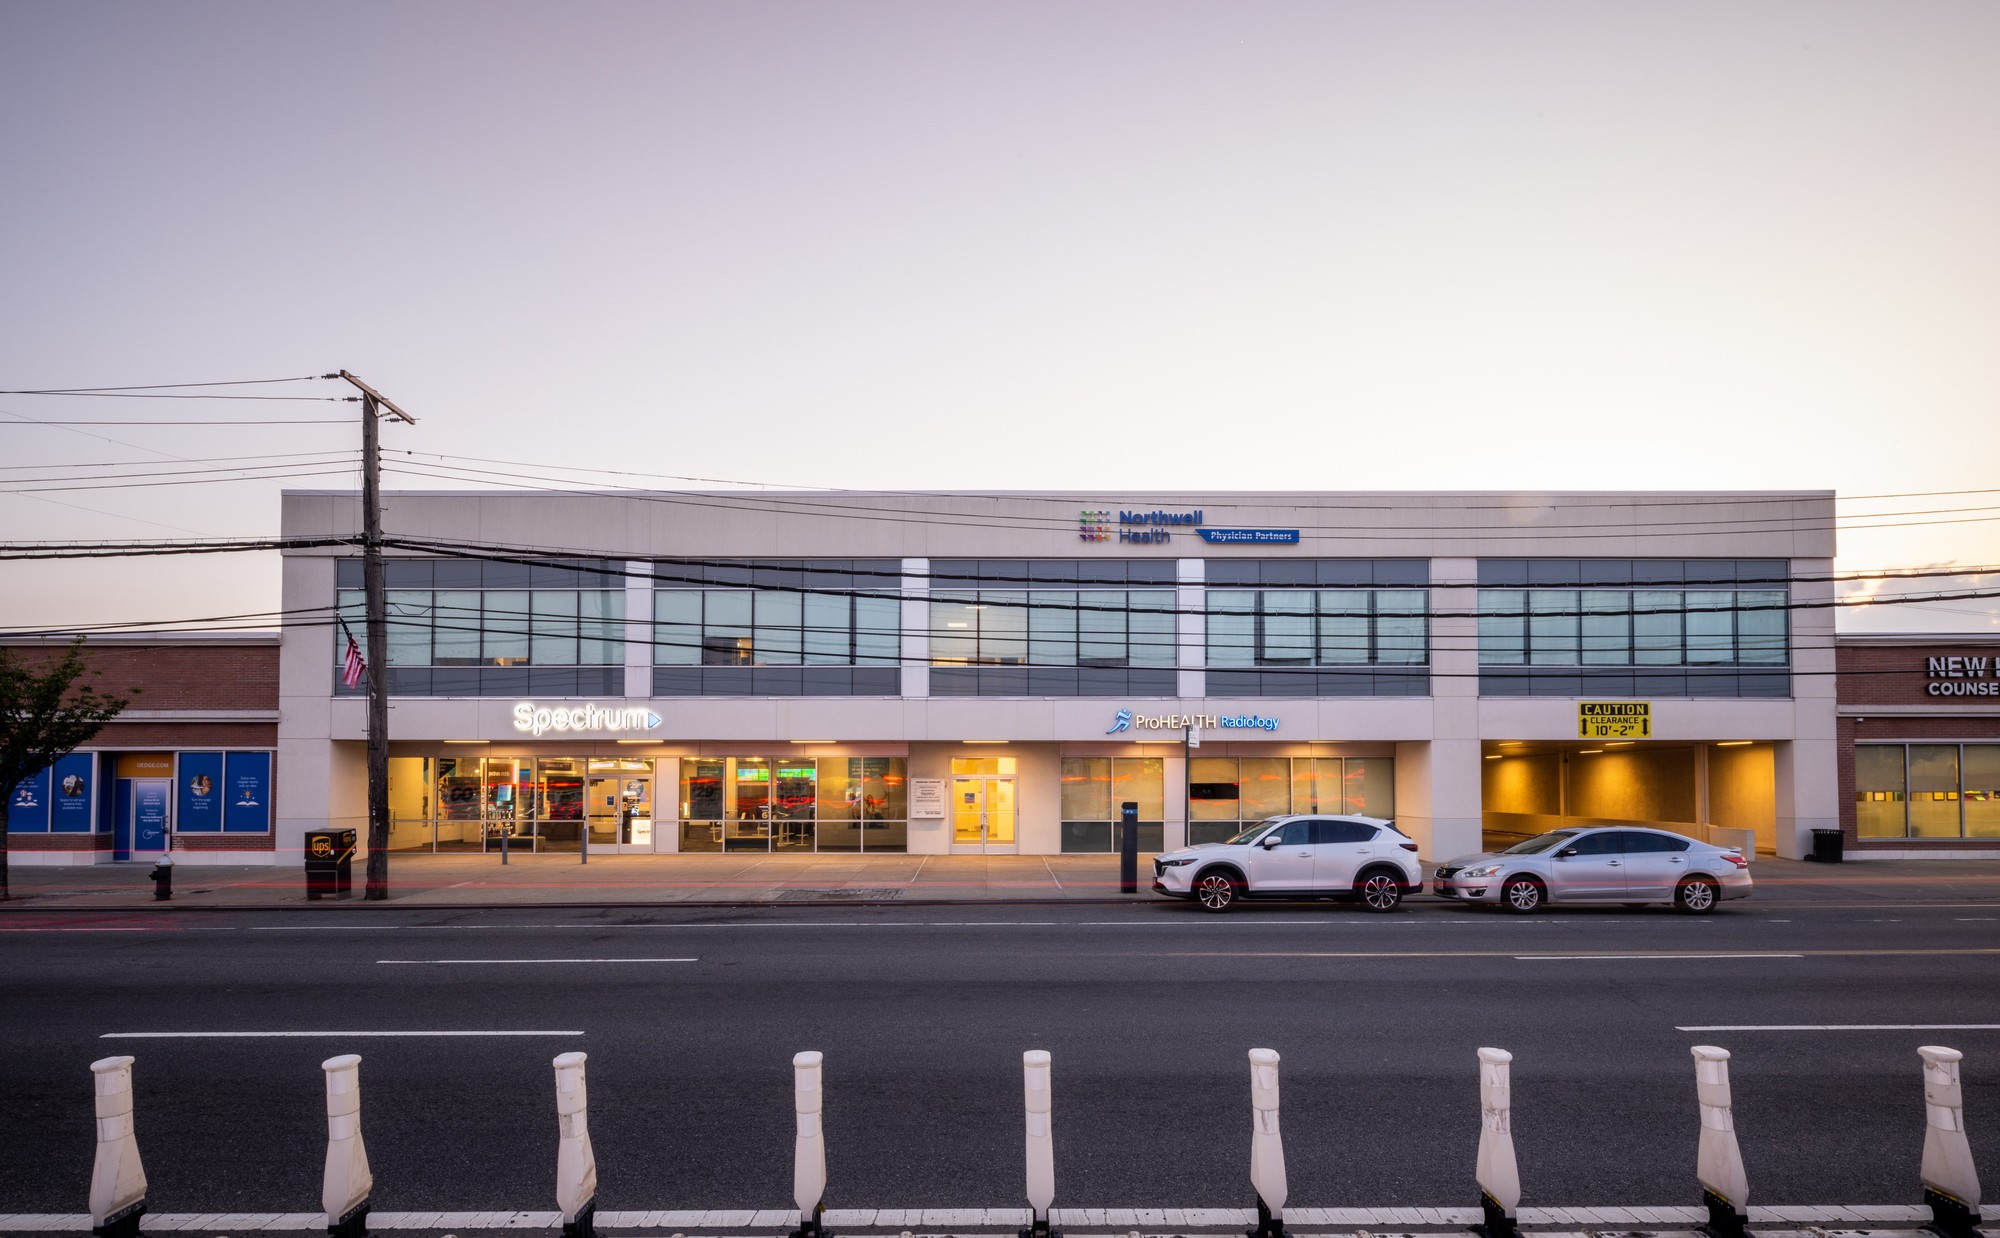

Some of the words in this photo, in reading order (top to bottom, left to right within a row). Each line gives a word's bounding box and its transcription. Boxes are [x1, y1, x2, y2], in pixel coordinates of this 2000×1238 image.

[1119, 510, 1203, 525] Northwell
[1119, 528, 1171, 544] Health
[1210, 531, 1253, 541] Physician
[1255, 531, 1293, 541] Partners
[1929, 656, 1987, 677] NEW
[1928, 682, 2000, 696] COUNSE
[1584, 704, 1645, 715] CAUTION
[514, 703, 650, 737] Spectrum
[1220, 715, 1280, 731] Radiology
[314, 843, 329, 854] ups
